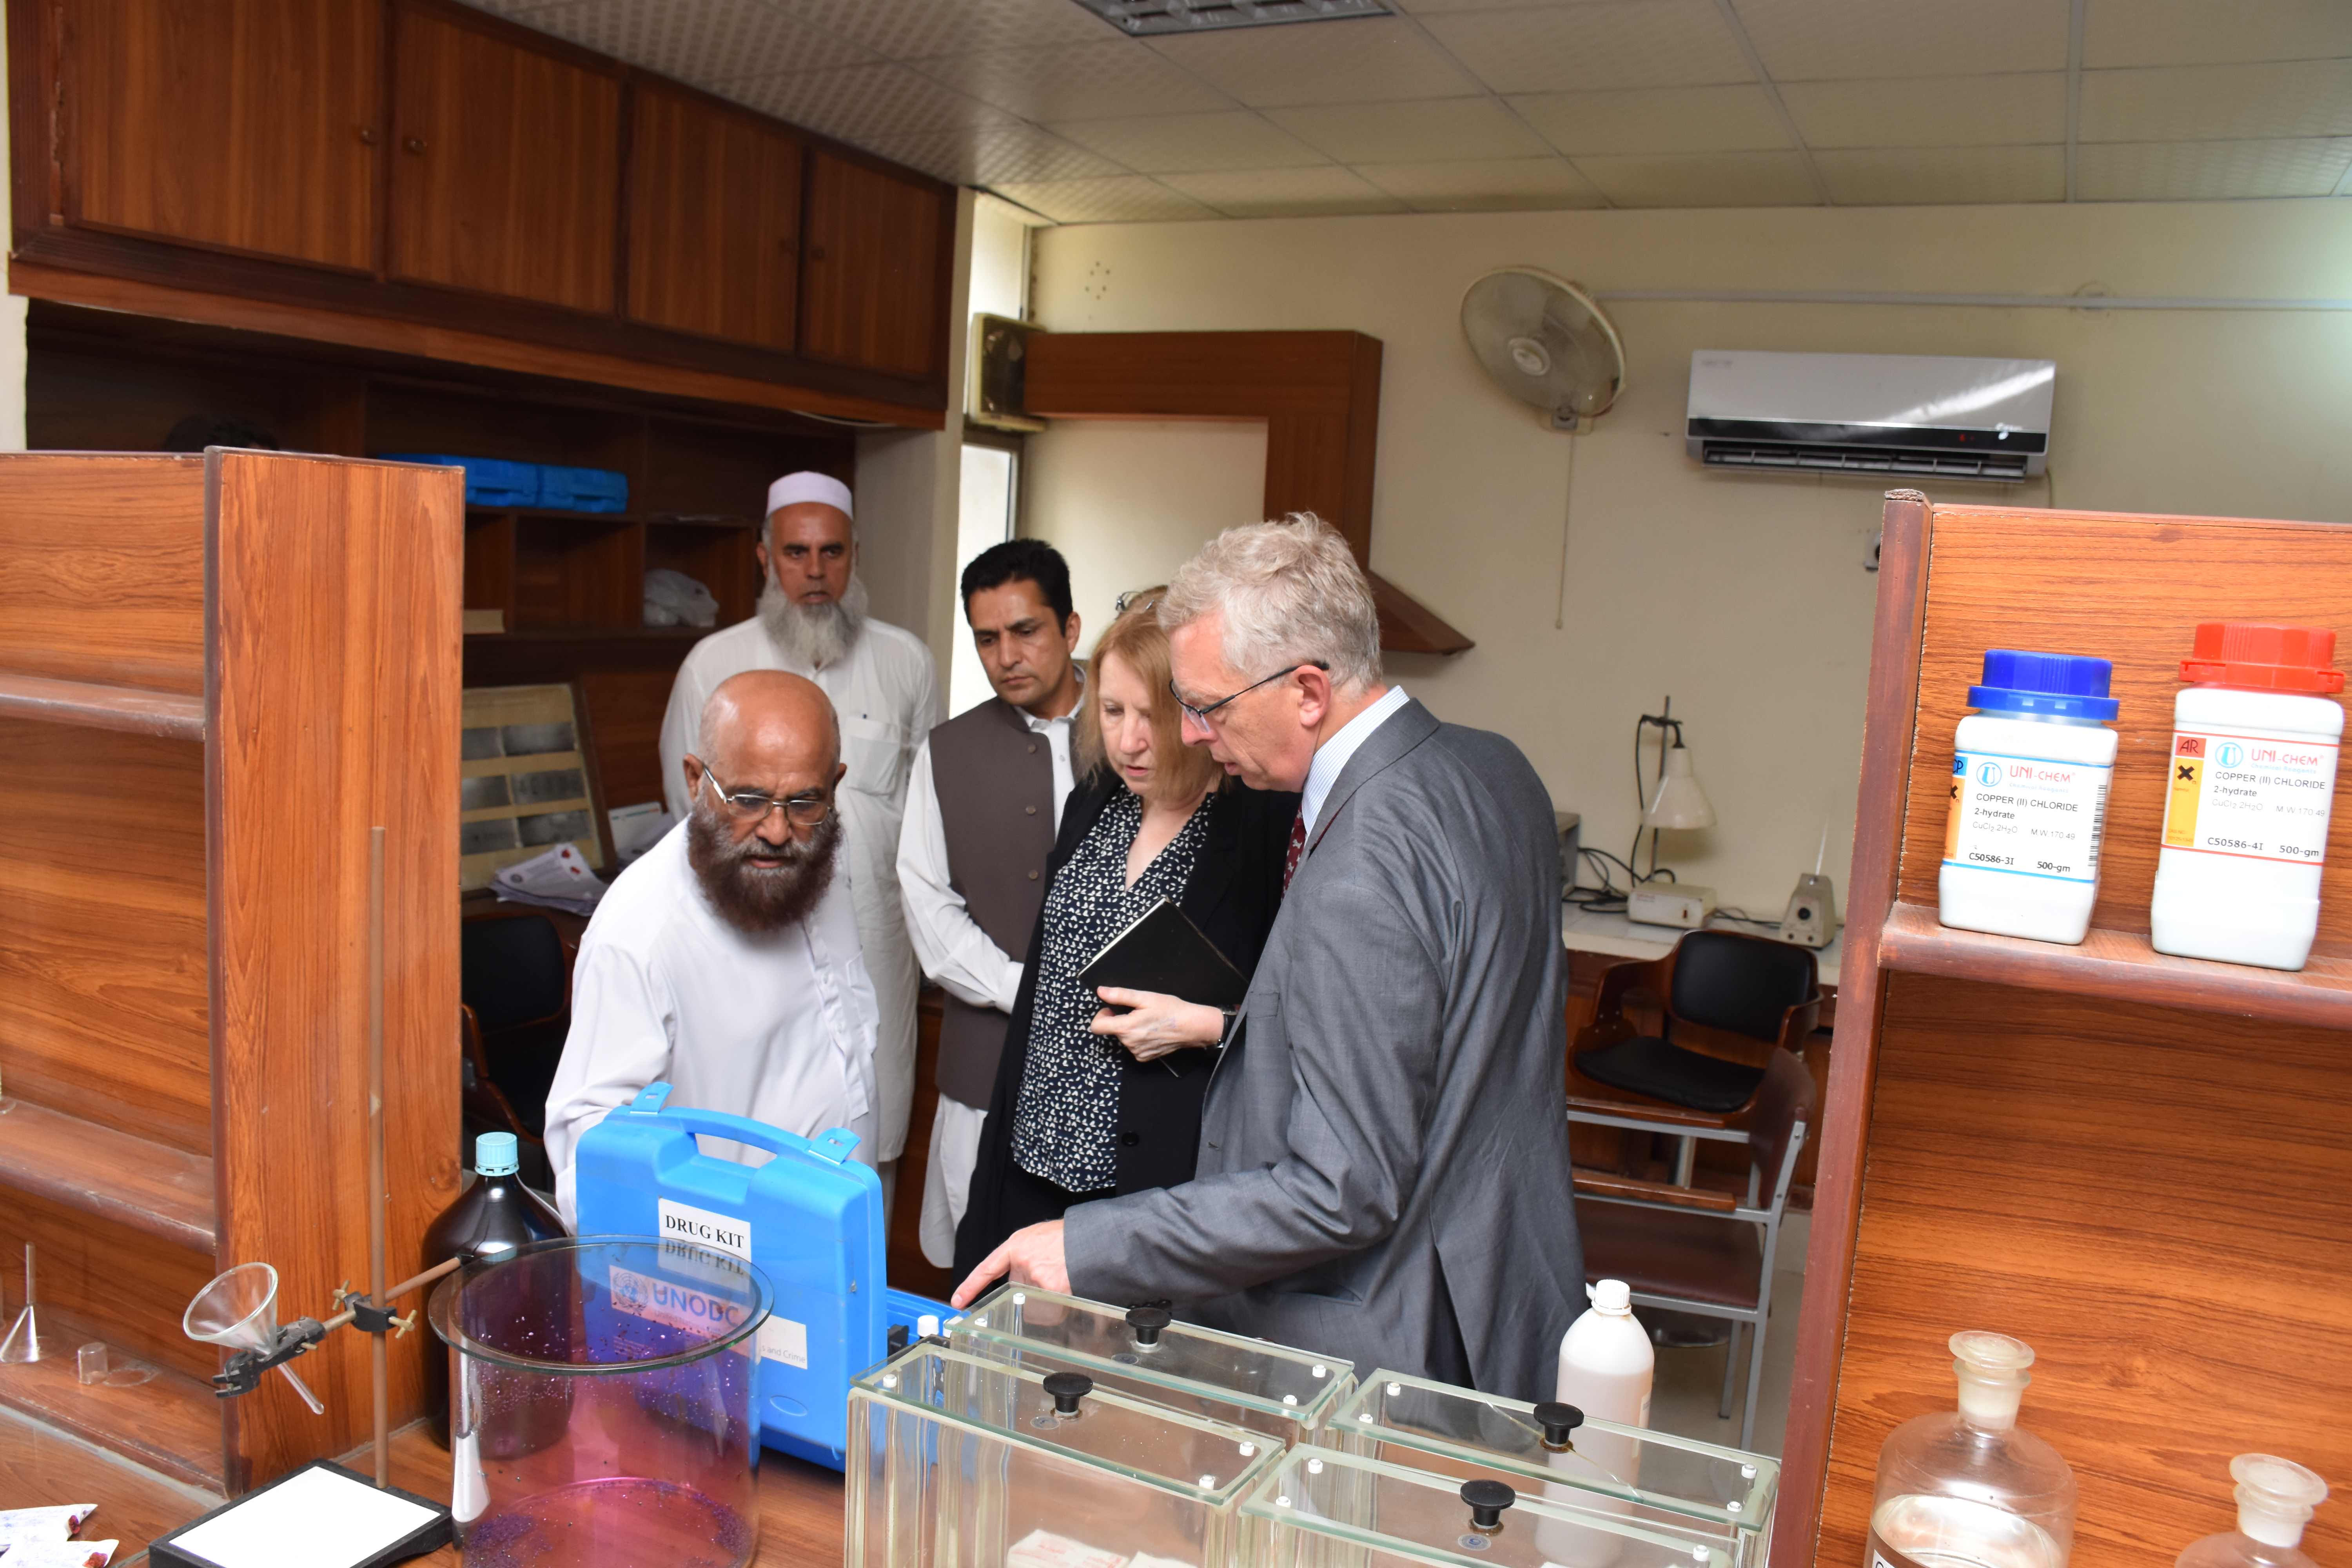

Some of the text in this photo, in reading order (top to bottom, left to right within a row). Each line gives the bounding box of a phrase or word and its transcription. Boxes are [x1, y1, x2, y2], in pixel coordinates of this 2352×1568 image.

[2179, 739, 2199, 754] AR
[2216, 771, 2325, 789] COPPER (II) CHLORIDE
[2214, 786, 2257, 797] 2-hydrate
[1976, 793, 2078, 812] COPPER (II) CHLORIDE
[1974, 808, 2015, 819] 2-hydrate
[2279, 845, 2319, 858] 500-gm
[2037, 861, 2071, 873] 500-gm
[665, 1214, 744, 1249] DRUG KIT
[653, 1283, 739, 1329] UNODC
[767, 1346, 781, 1356] and
[783, 1350, 806, 1363] Crime
